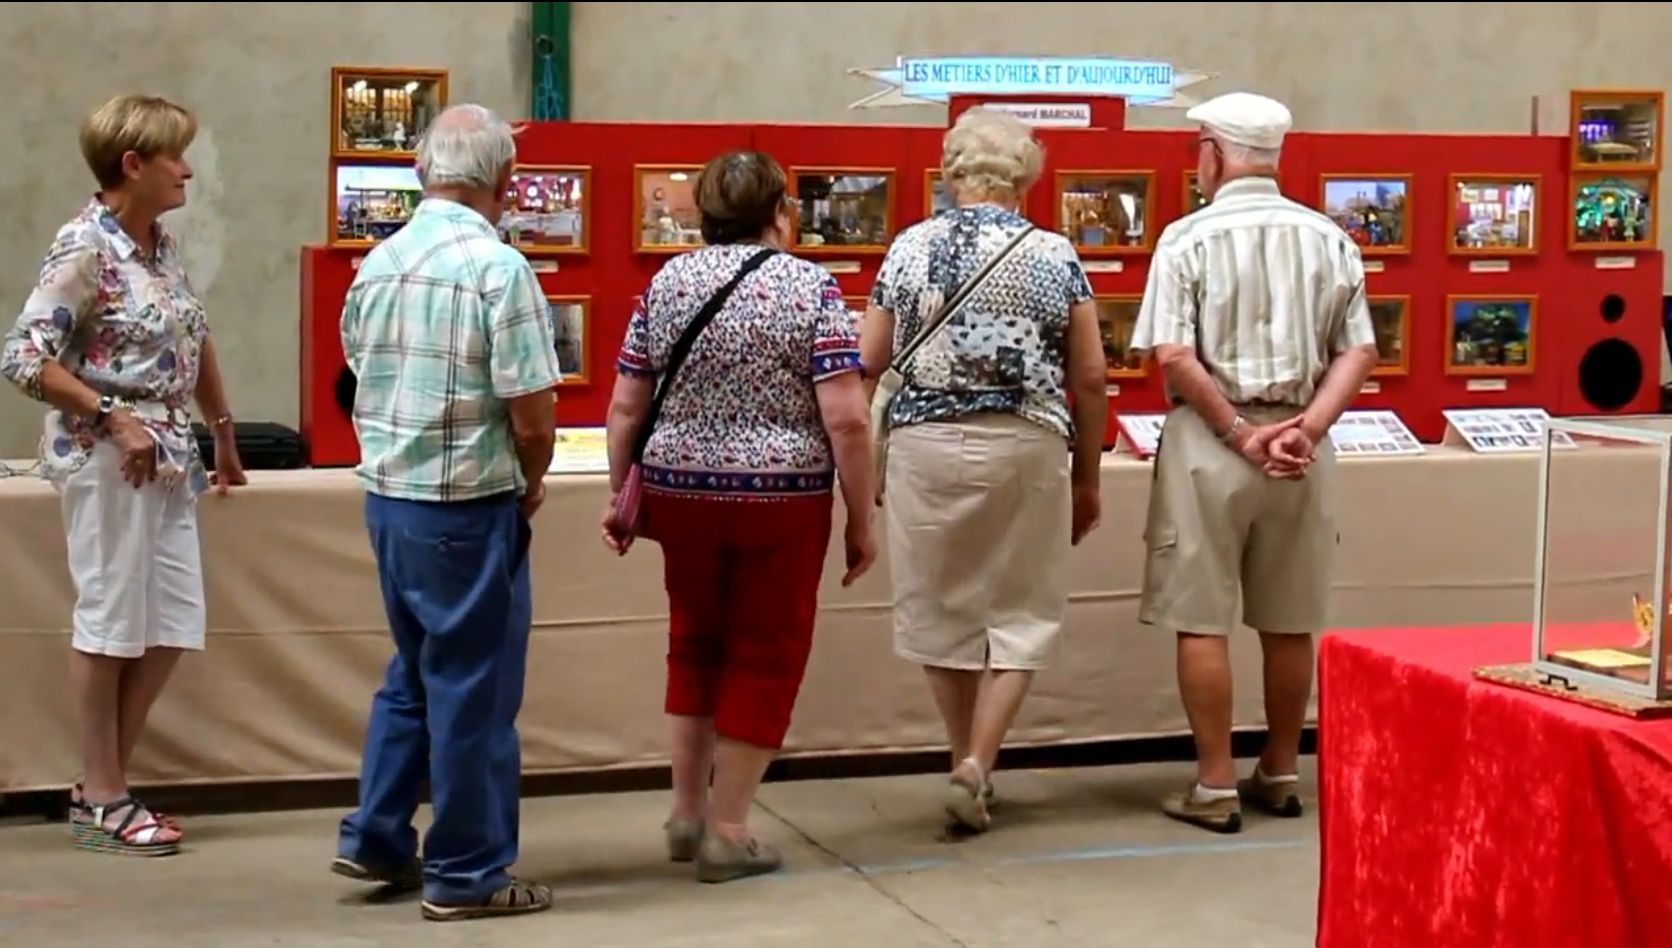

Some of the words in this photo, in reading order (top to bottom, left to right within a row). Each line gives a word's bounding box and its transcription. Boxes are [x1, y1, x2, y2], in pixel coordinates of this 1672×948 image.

[904, 63, 929, 82] LES
[931, 63, 992, 83] METIERS
[995, 64, 1041, 84] D'HIER
[1045, 65, 1062, 84] ET
[1066, 65, 1171, 85] D'AUJOURD'HUI
[1039, 108, 1087, 120] MARCHAL
